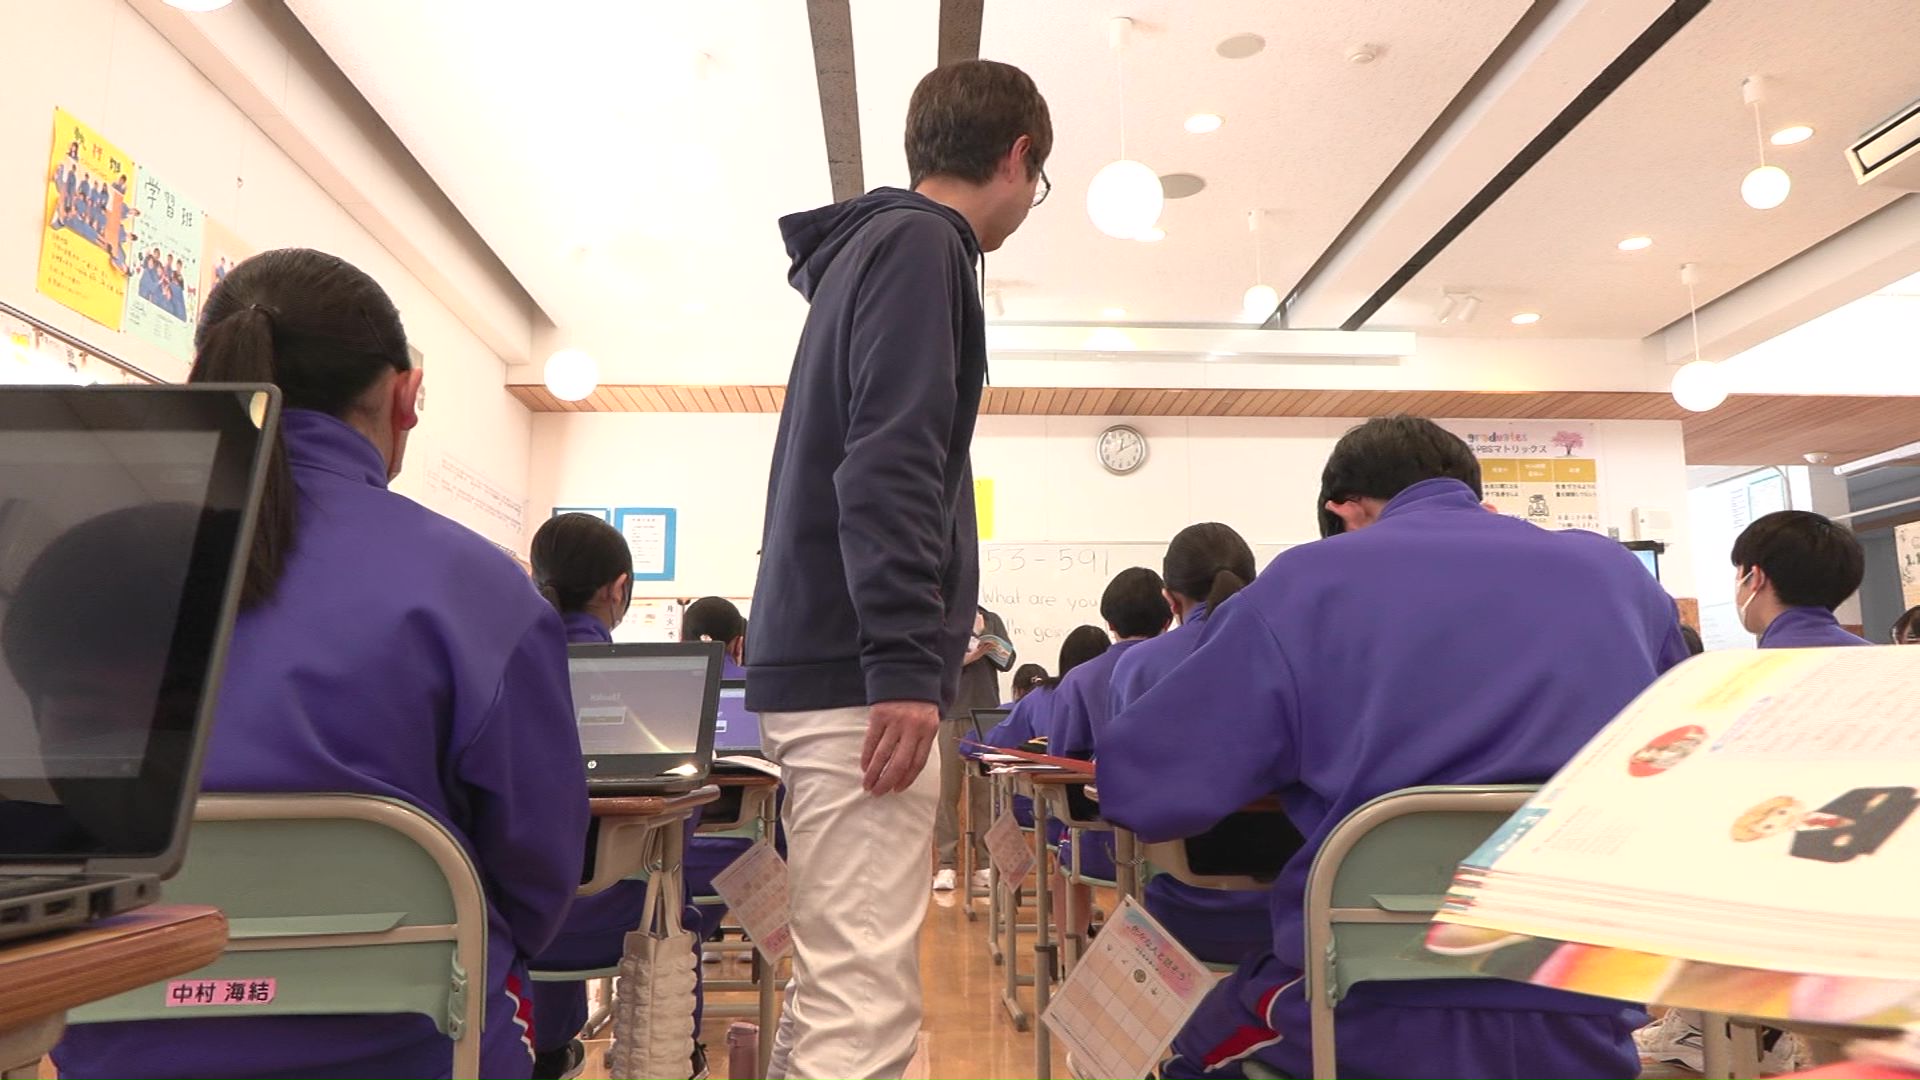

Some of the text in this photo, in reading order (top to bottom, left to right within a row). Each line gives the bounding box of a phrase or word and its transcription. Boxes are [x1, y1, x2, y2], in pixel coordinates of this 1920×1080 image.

[144, 176, 192, 227] 学習班
[982, 583, 1099, 612] What are you
[172, 980, 269, 1003] 中村 海結
